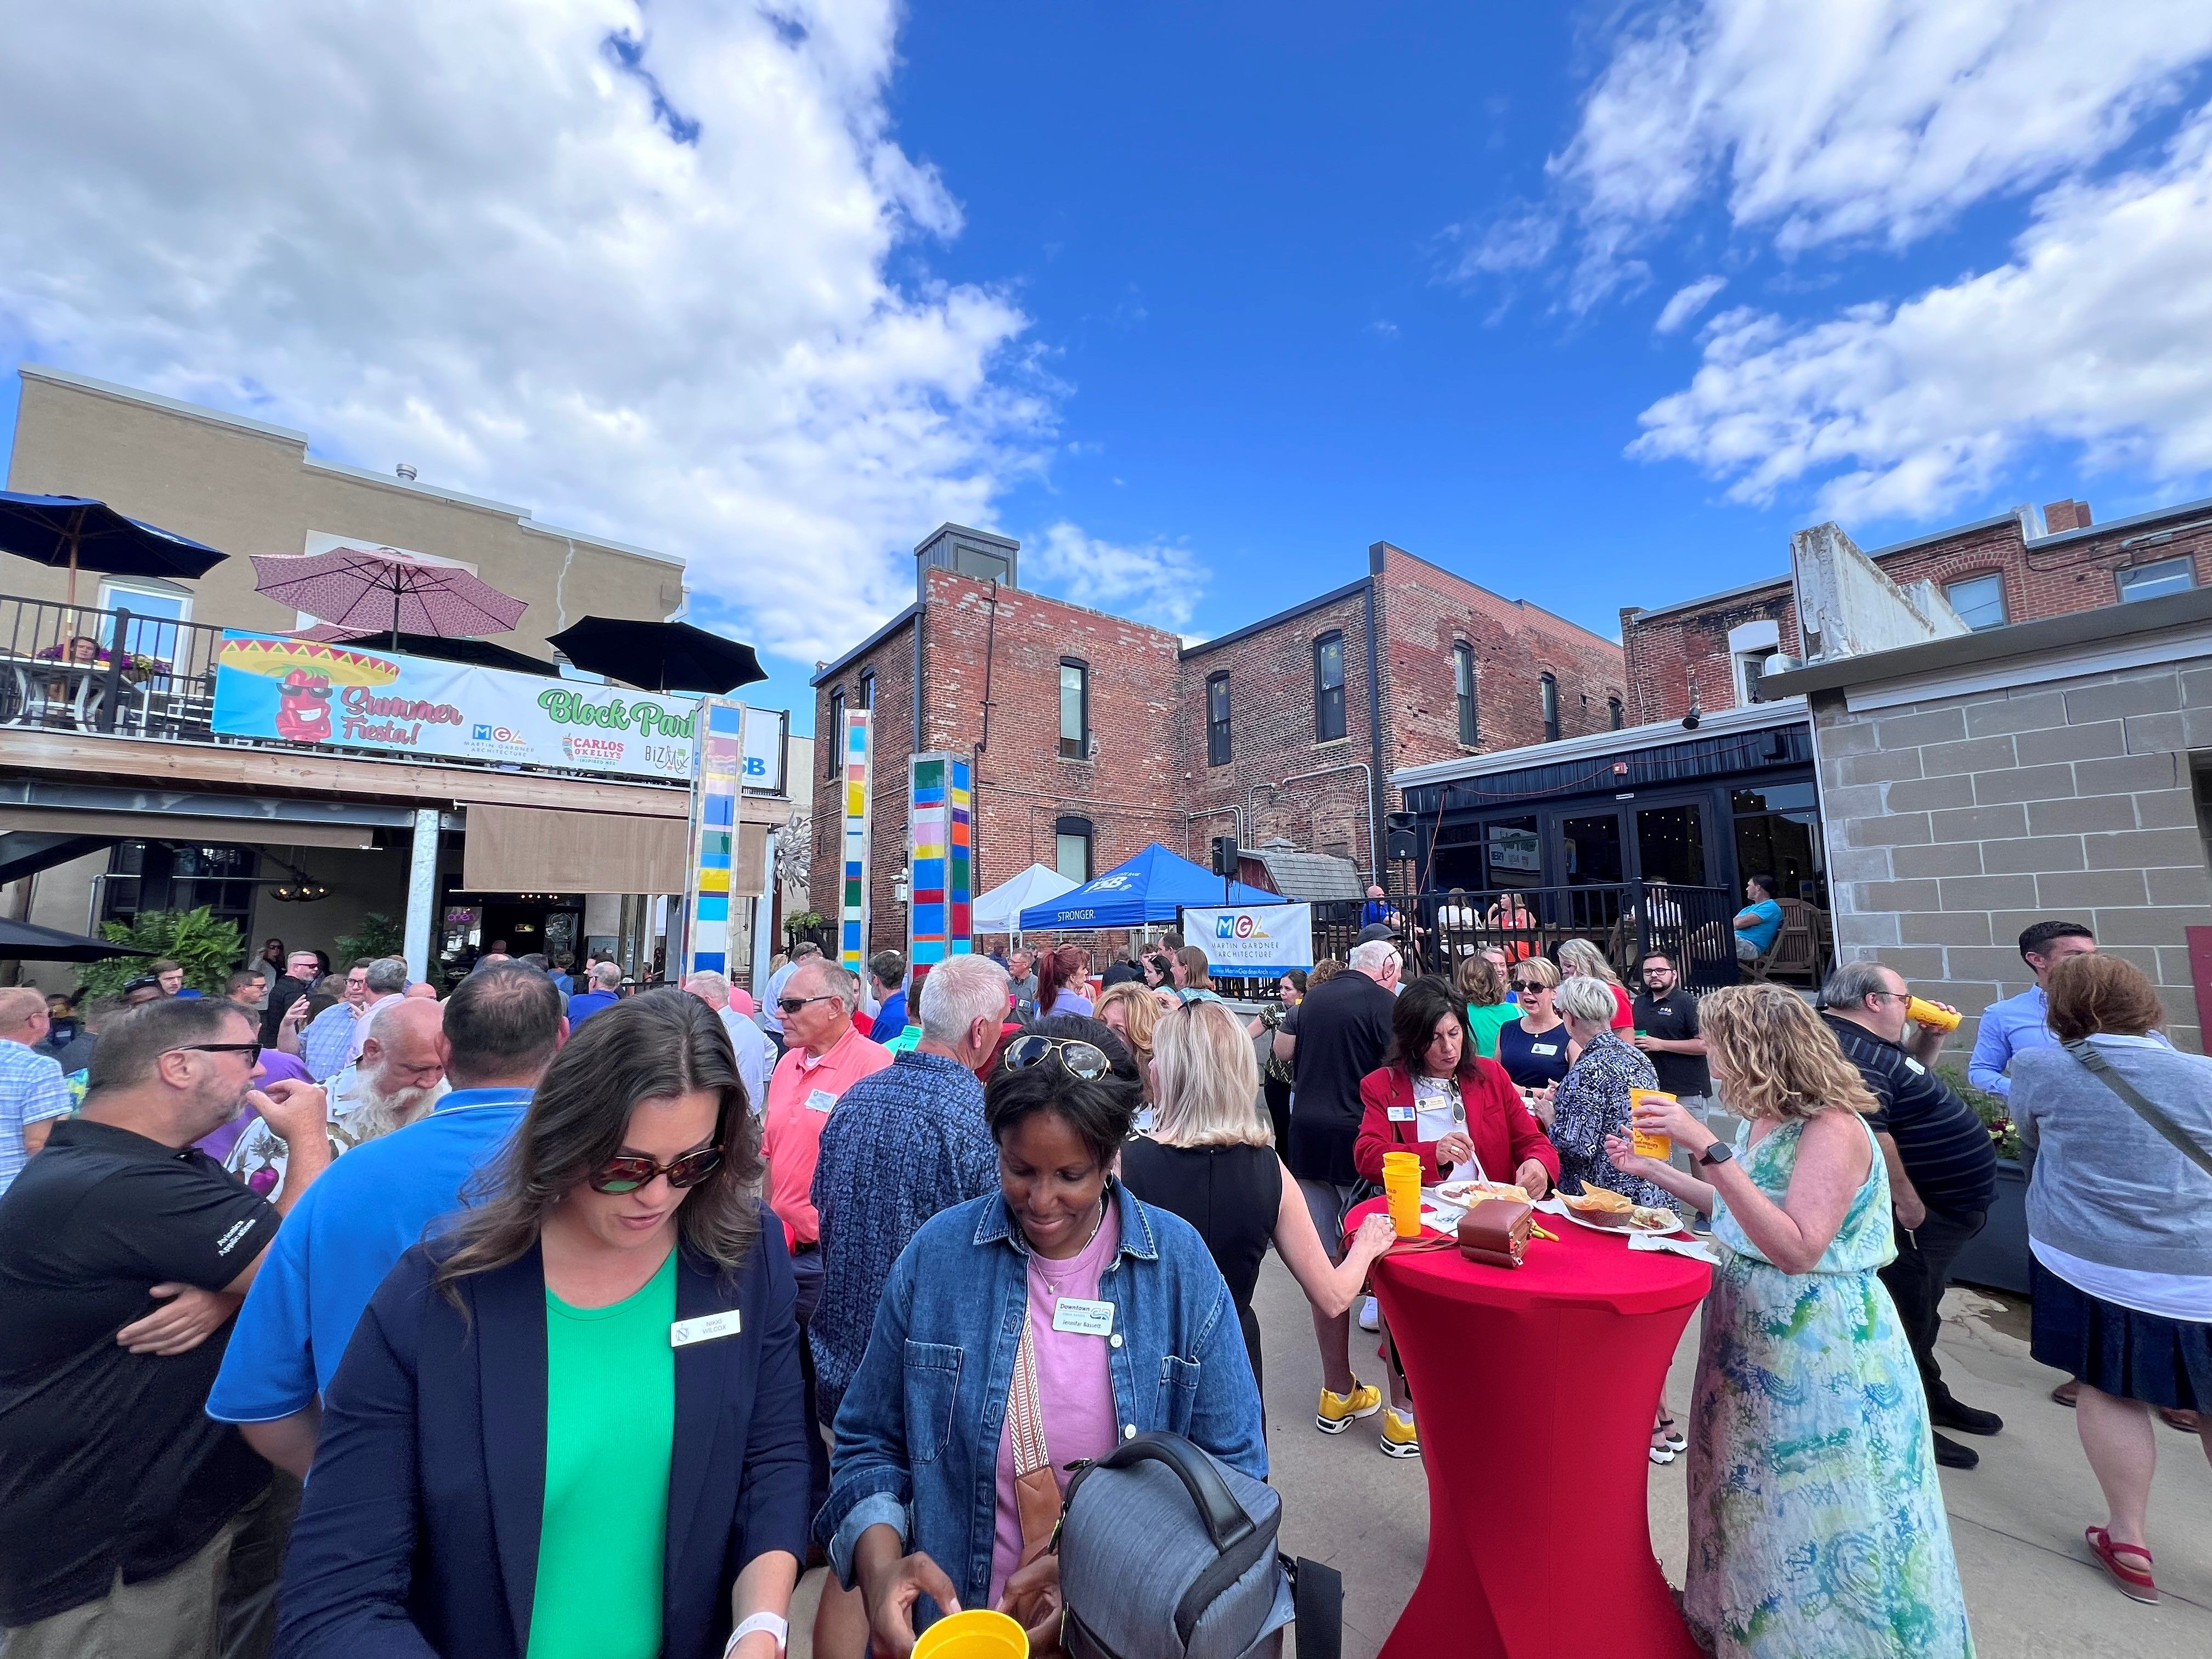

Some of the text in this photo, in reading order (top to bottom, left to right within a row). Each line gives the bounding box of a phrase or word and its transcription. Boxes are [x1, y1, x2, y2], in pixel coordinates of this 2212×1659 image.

[341, 686, 463, 726] Summer
[538, 689, 697, 739] Block Part
[341, 715, 422, 745] Fiesta!
[498, 744, 535, 752] GARDNER
[574, 738, 624, 752] CARLOS
[471, 748, 526, 757] ARCHITECTURE
[574, 748, 622, 759] O'KELLY'S
[1216, 915, 1270, 939] MGA
[217, 1220, 244, 1247] Avionics
[218, 1219, 256, 1256] Applications
[1060, 1304, 1090, 1312] Downtown
[702, 1324, 726, 1335] WILCOX
[706, 1318, 723, 1327] NIKKI
